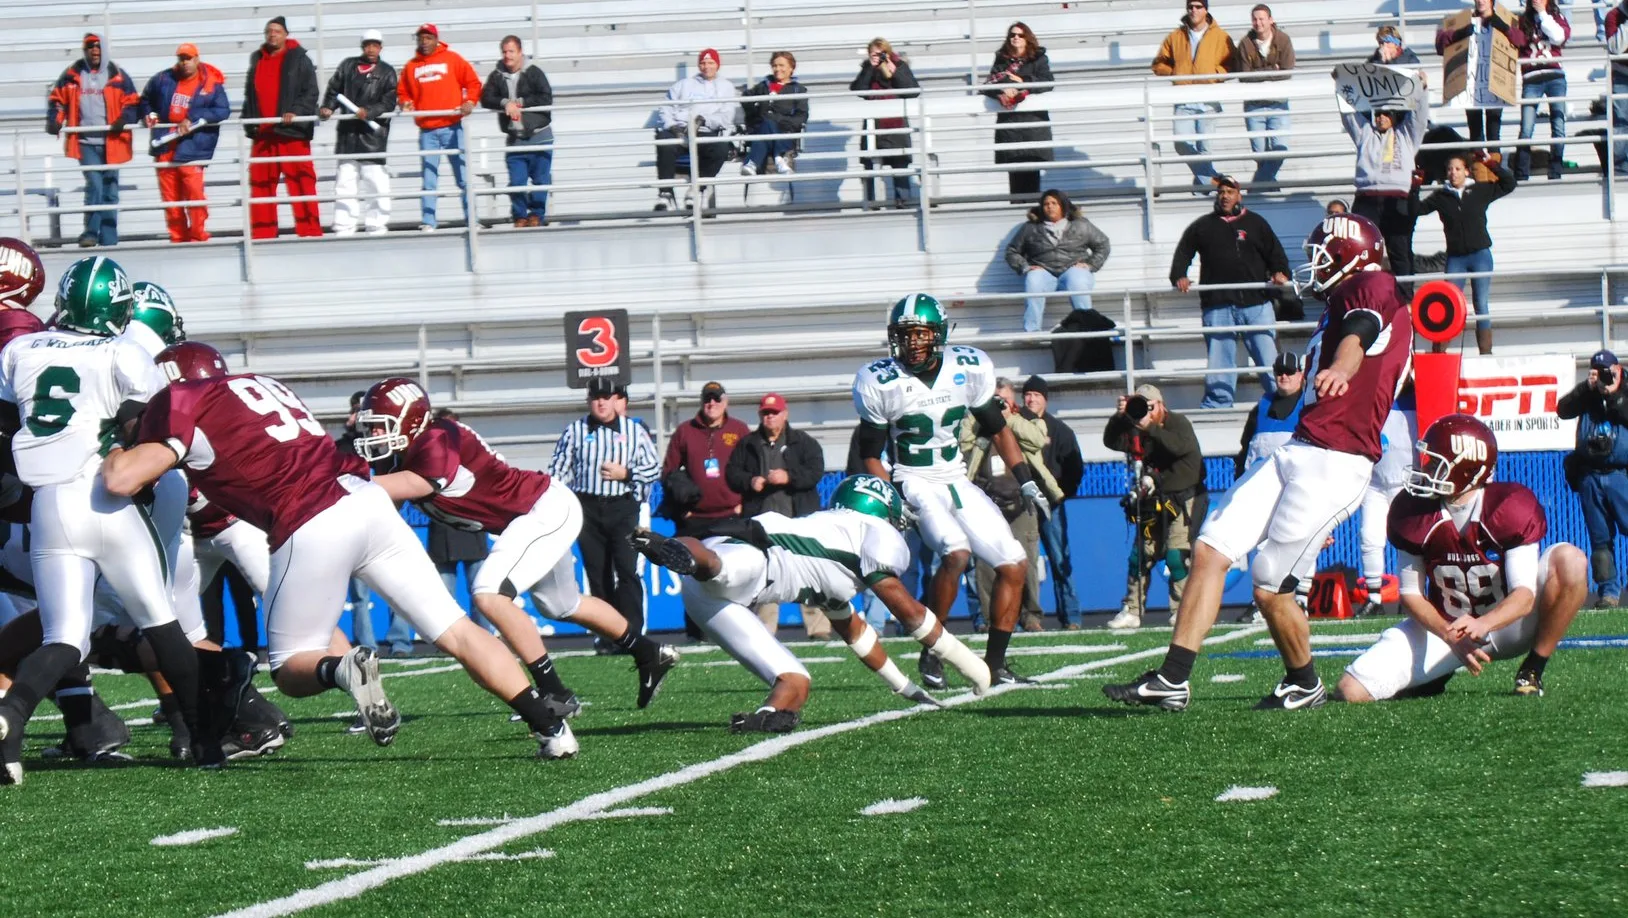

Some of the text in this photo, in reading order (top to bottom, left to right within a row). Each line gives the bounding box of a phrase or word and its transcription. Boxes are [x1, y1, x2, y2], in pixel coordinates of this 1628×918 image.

[1358, 73, 1415, 98] UMD
[1322, 216, 1363, 242] UMD
[0, 246, 34, 280] UMD
[576, 316, 619, 368] 3
[26, 365, 81, 438] 6
[227, 375, 326, 443] 99
[386, 383, 424, 406] UMD
[1457, 373, 1558, 417] SPN
[897, 404, 966, 466] 23
[1485, 416, 1560, 433] ADER IN SPORTS
[1450, 434, 1488, 462] UMD
[1307, 578, 1336, 615] 20
[1433, 563, 1505, 618] 89
